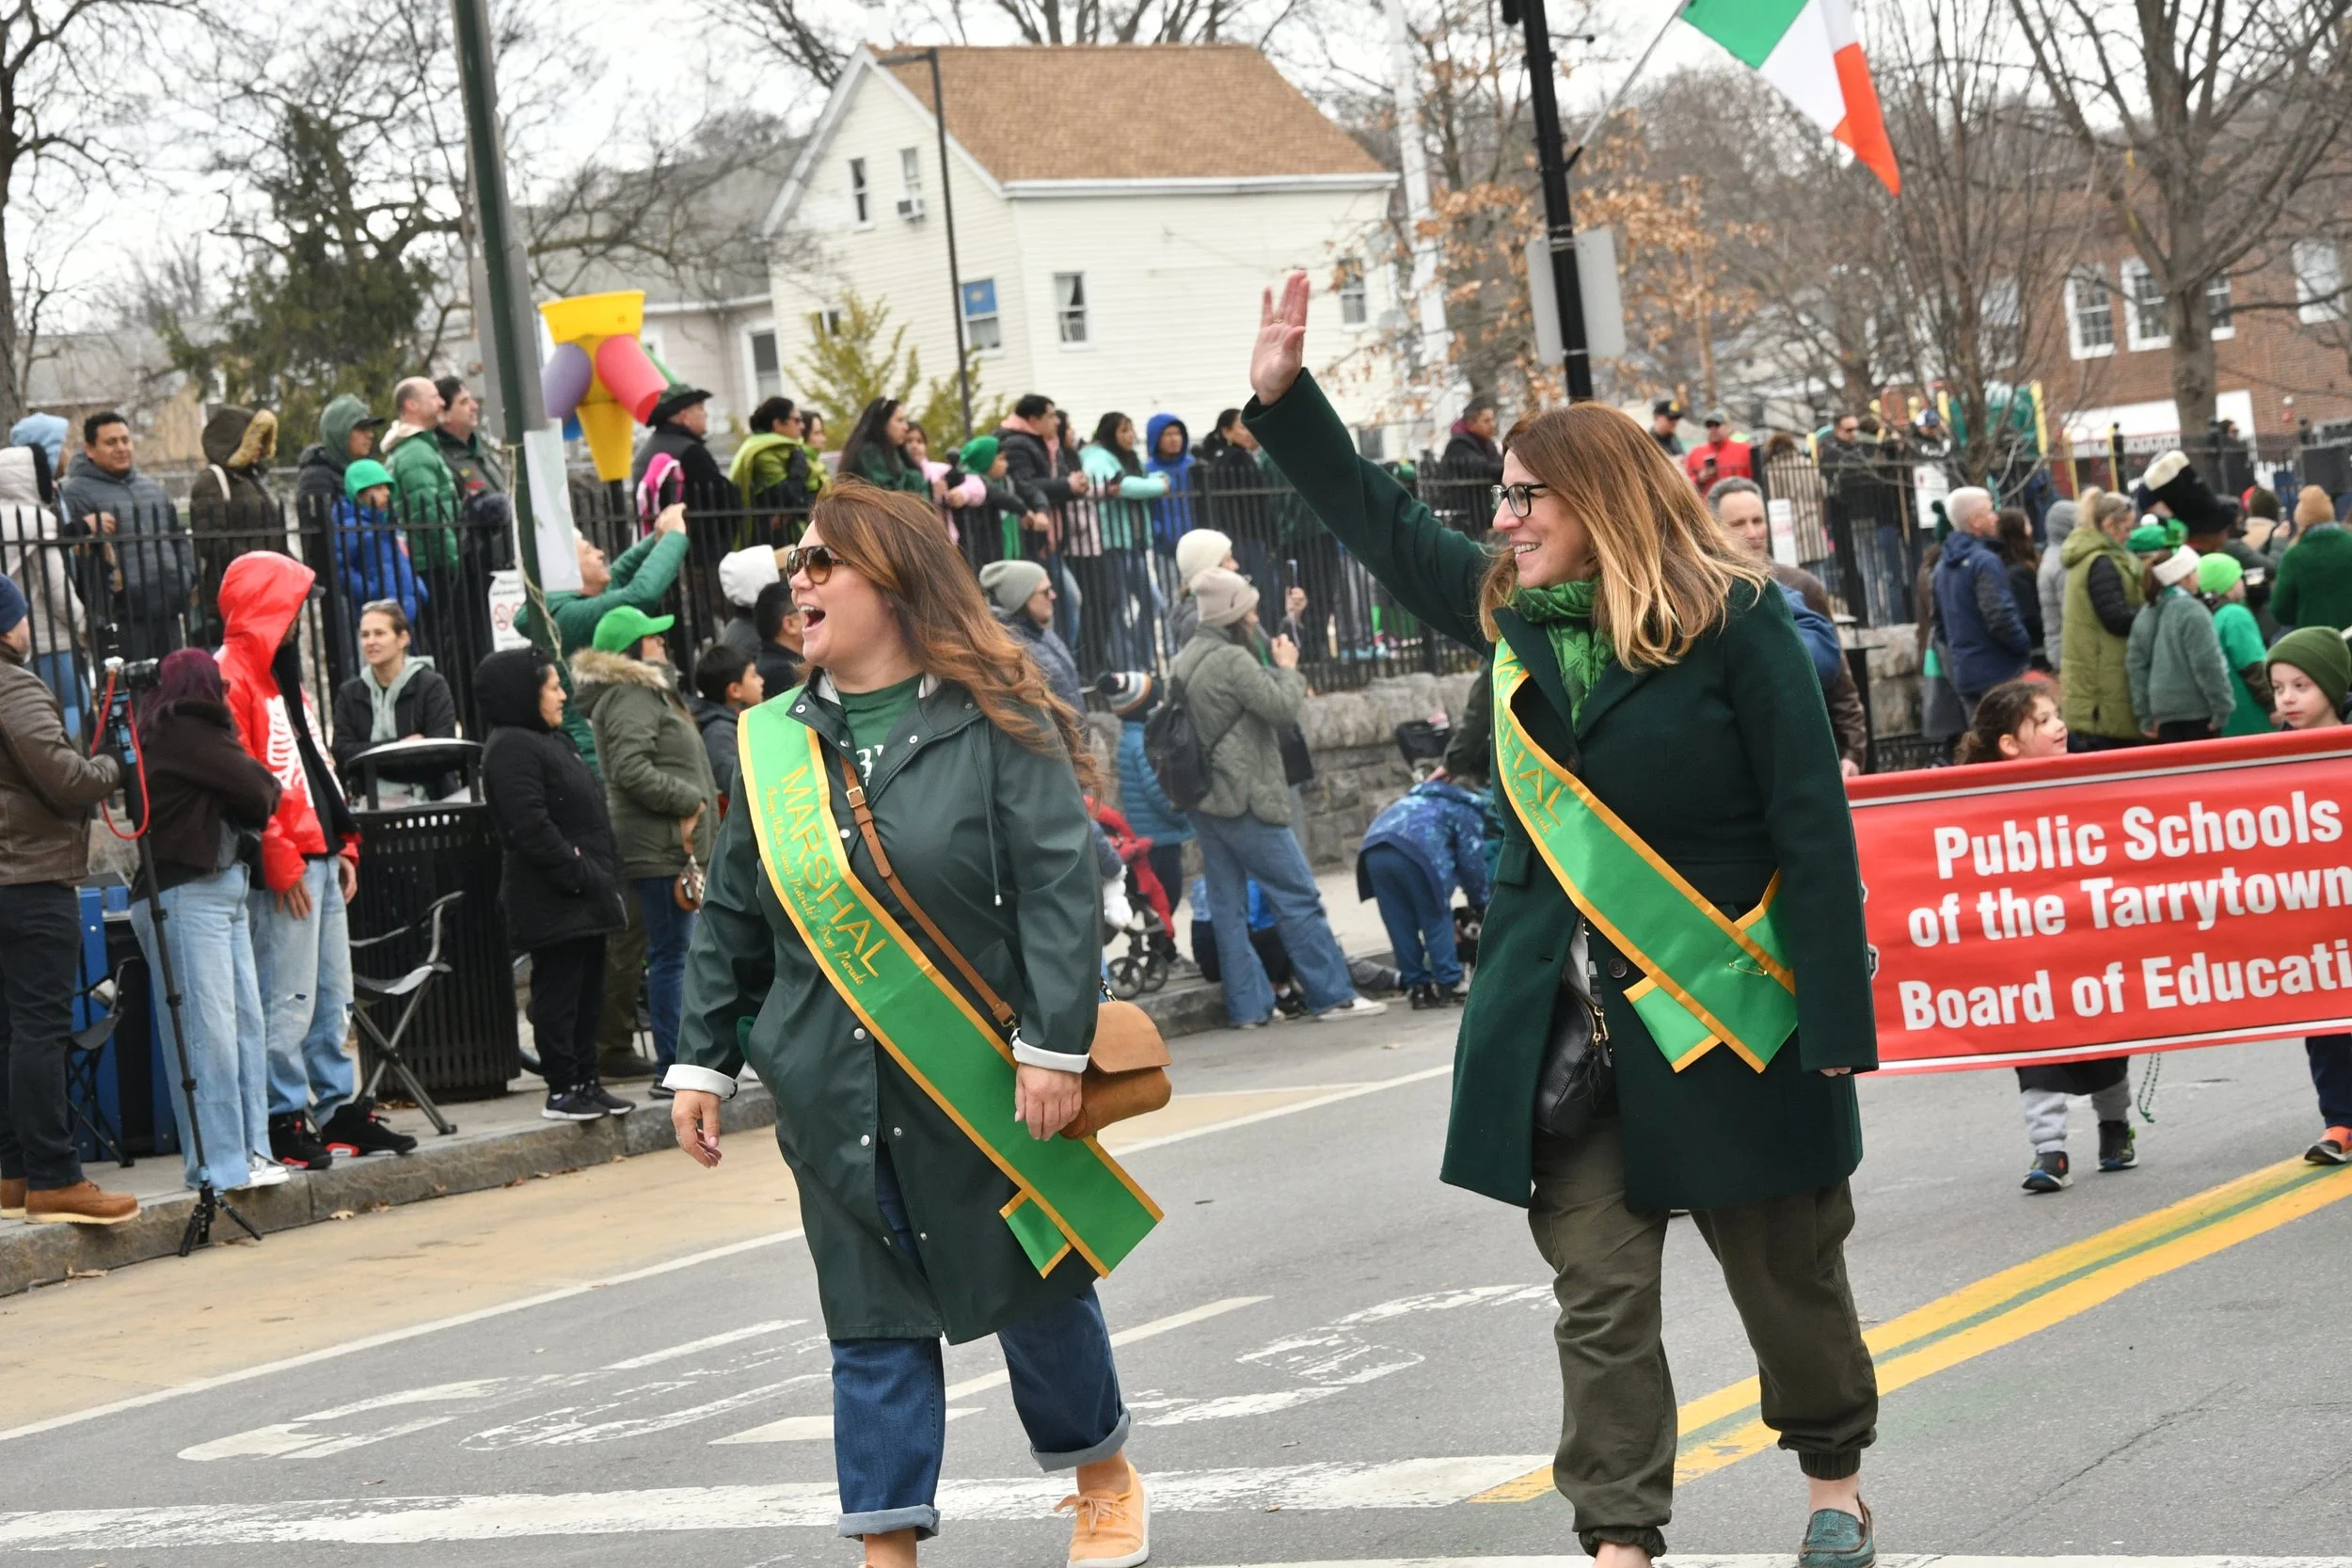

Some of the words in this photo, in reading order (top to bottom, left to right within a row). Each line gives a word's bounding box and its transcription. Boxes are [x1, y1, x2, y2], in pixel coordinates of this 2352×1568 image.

[780, 763, 887, 978] MARSHAL
[1933, 815, 2108, 879] Public
[2122, 790, 2344, 862] Schools
[1907, 892, 1962, 948] of
[1976, 887, 2067, 942] the
[834, 950, 868, 987] Parade
[1898, 969, 2056, 1032] Board
[2071, 960, 2125, 1018] of
